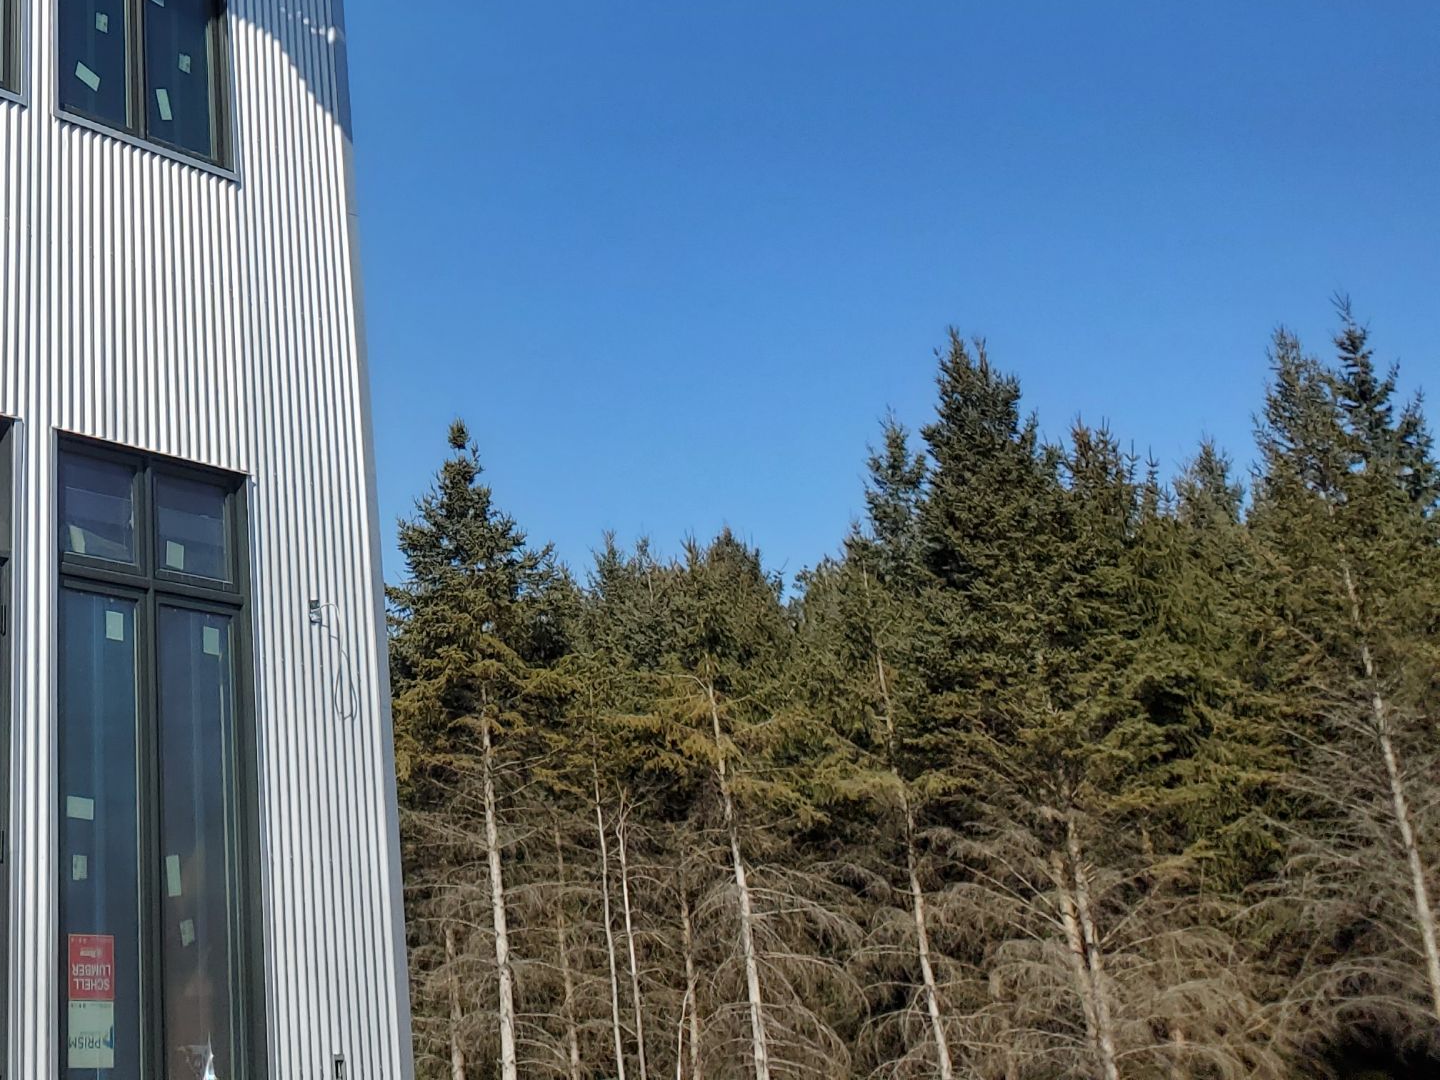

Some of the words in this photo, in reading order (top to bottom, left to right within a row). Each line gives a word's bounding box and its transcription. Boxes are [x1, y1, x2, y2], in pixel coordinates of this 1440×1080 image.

[71, 963, 112, 977] LUMBER
[73, 978, 111, 991] SCHELL
[68, 1035, 101, 1049] PRISM
